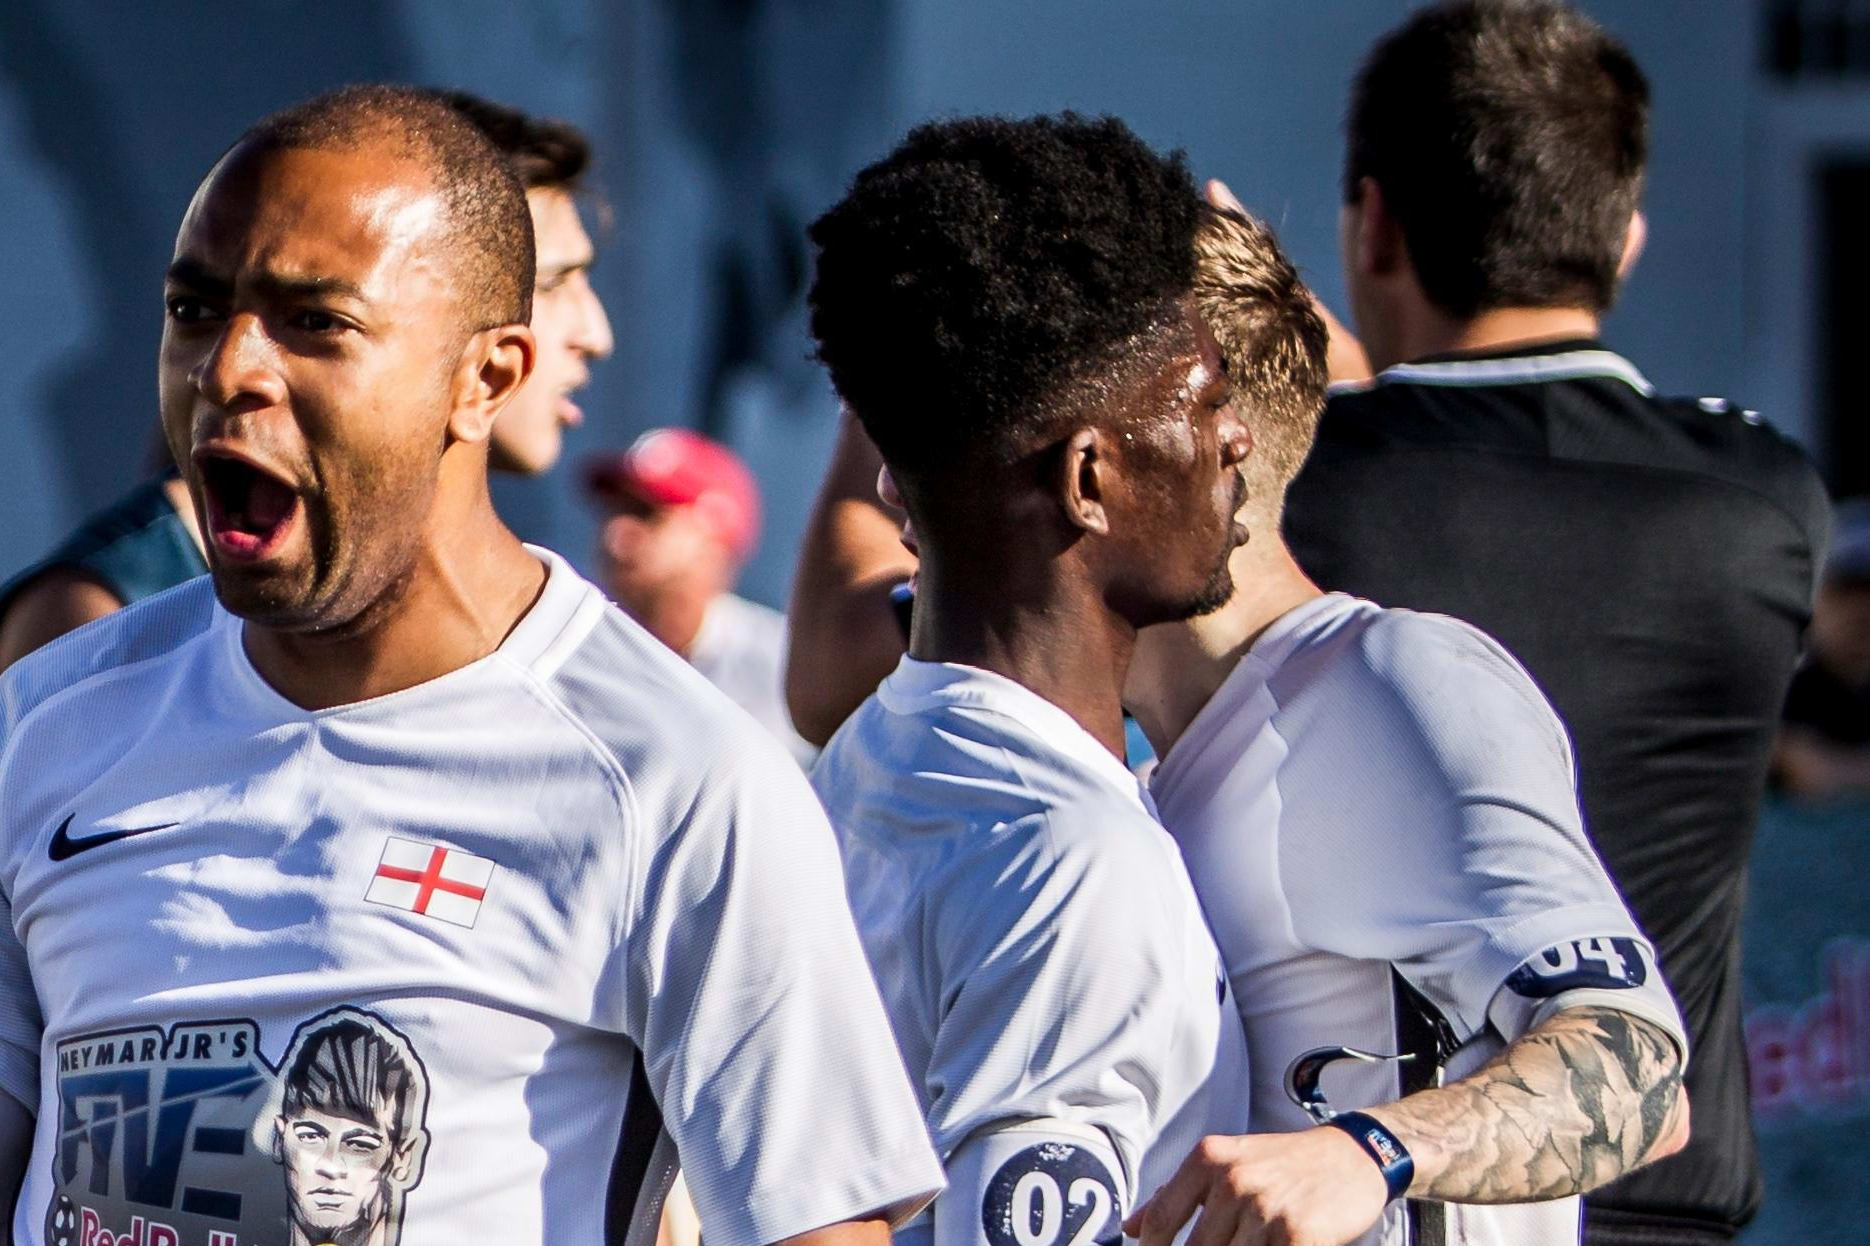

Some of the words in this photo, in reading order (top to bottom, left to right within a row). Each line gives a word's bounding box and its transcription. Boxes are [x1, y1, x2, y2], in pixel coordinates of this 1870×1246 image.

[1529, 938, 1627, 979] 04
[60, 1037, 158, 1073] NEYMAR
[173, 1031, 248, 1060] JR'S
